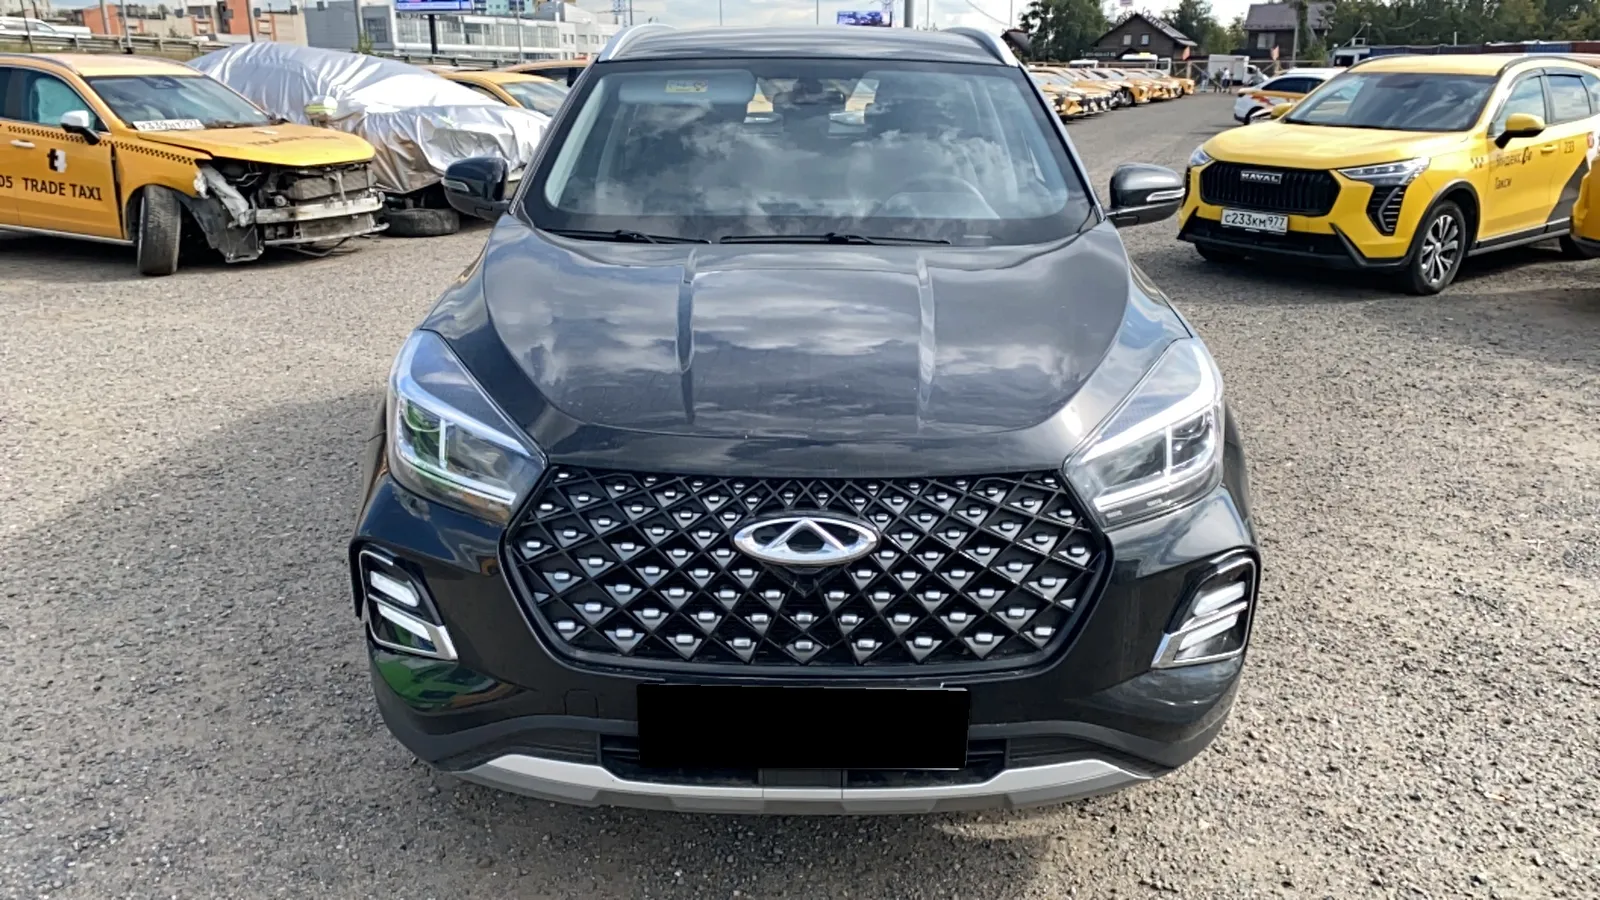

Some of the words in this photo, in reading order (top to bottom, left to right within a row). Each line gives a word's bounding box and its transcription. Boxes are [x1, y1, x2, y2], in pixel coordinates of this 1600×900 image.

[1241, 173, 1279, 182] HAVAL
[21, 177, 66, 196] TRADE
[69, 183, 103, 201] TAXI
